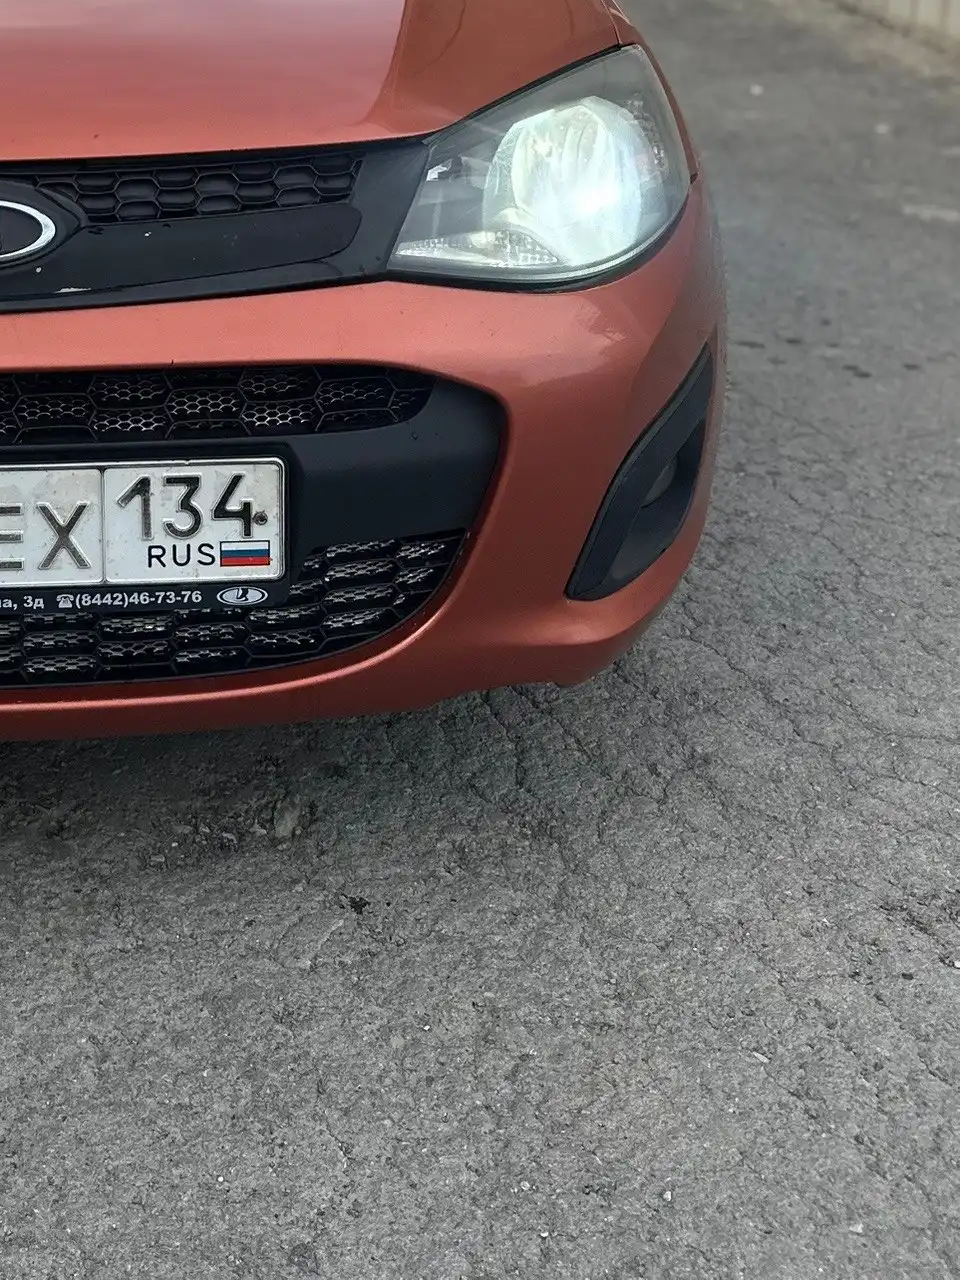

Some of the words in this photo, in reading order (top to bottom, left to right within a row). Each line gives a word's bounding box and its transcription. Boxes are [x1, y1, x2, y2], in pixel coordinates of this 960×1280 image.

[117, 472, 253, 540] 134
[147, 543, 216, 568] RUS
[75, 590, 203, 609] (8442)46-73-76
